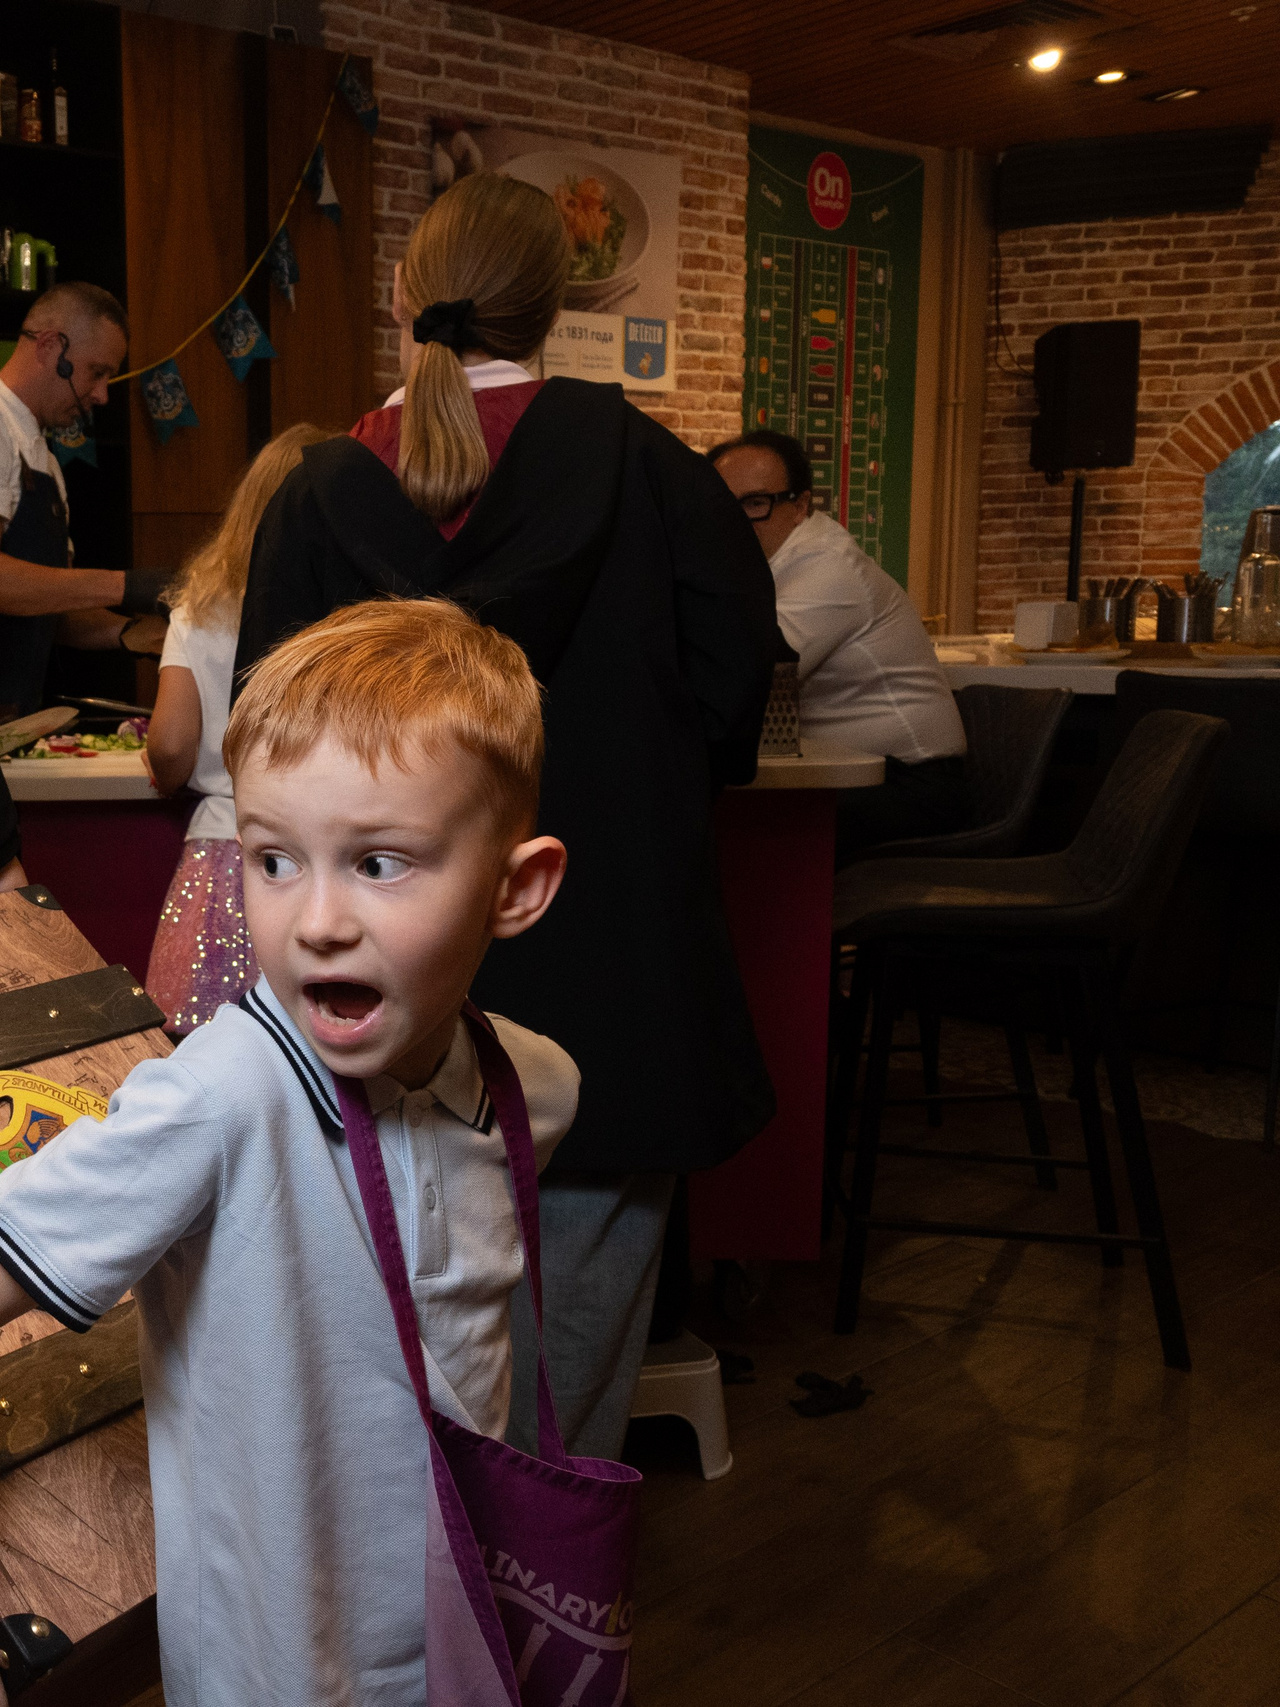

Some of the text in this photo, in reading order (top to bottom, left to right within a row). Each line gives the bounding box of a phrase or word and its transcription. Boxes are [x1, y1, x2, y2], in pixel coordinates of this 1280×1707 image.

[814, 166, 844, 199] On
[566, 325, 588, 340] 1831
[591, 330, 614, 344] года
[11, 1077, 86, 1113] TITILLANDUS
